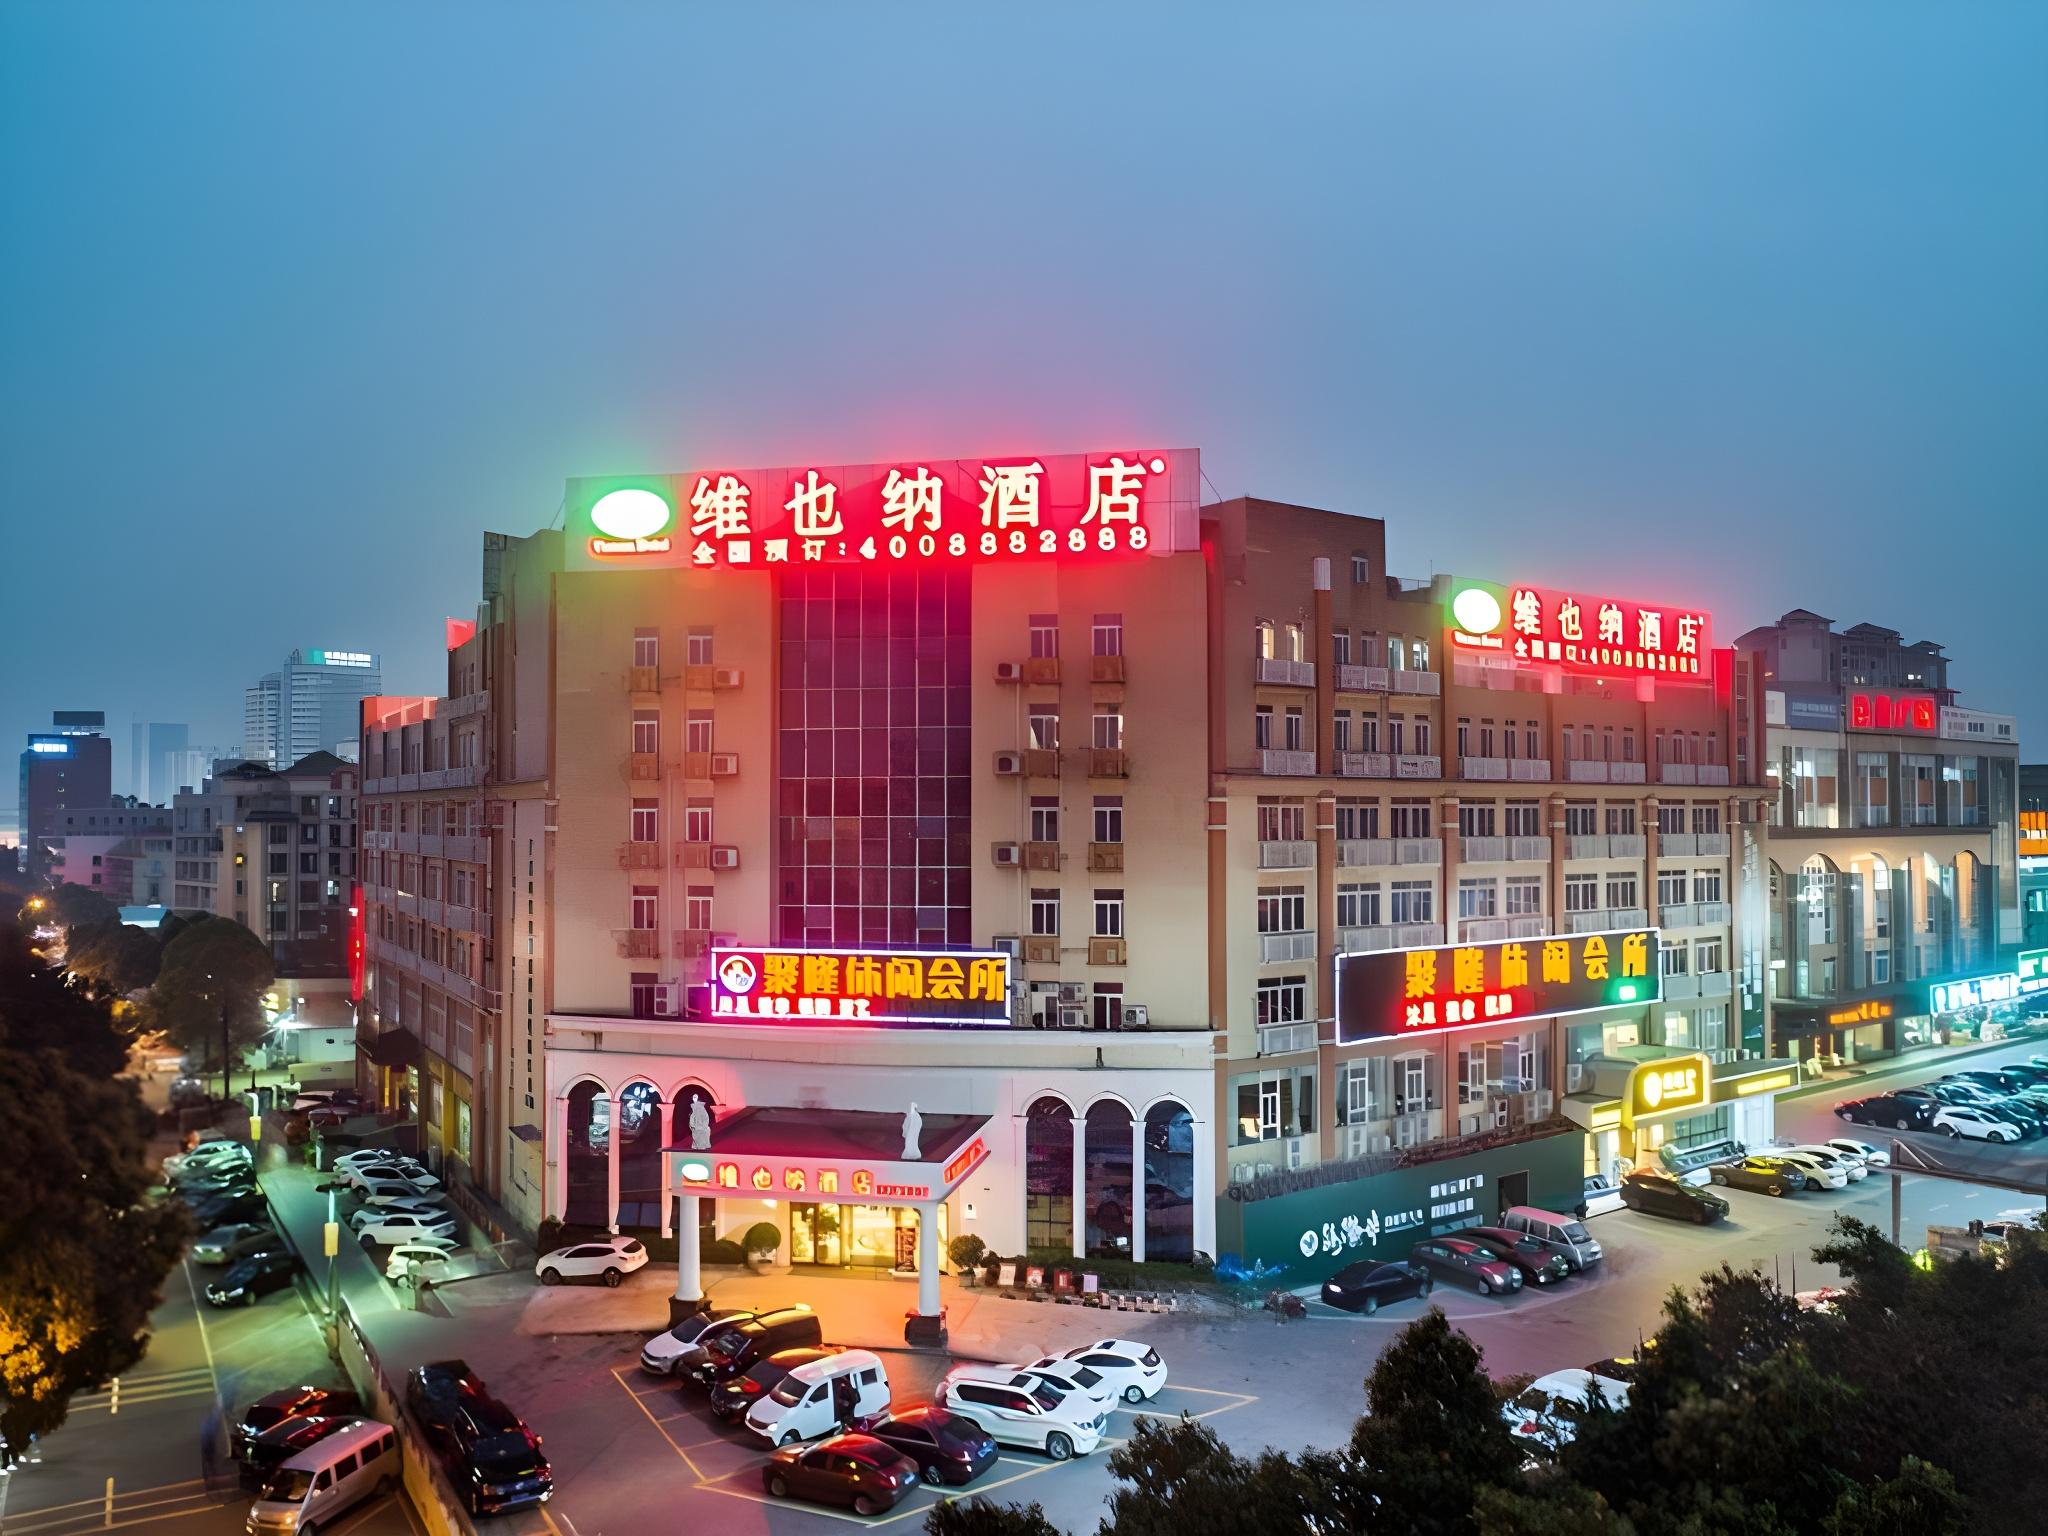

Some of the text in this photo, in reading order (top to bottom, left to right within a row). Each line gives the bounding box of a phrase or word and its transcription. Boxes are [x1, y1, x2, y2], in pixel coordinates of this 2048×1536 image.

[690, 458, 1147, 539] 维也纳酒店
[719, 1165, 870, 1194] 也纳酒店
